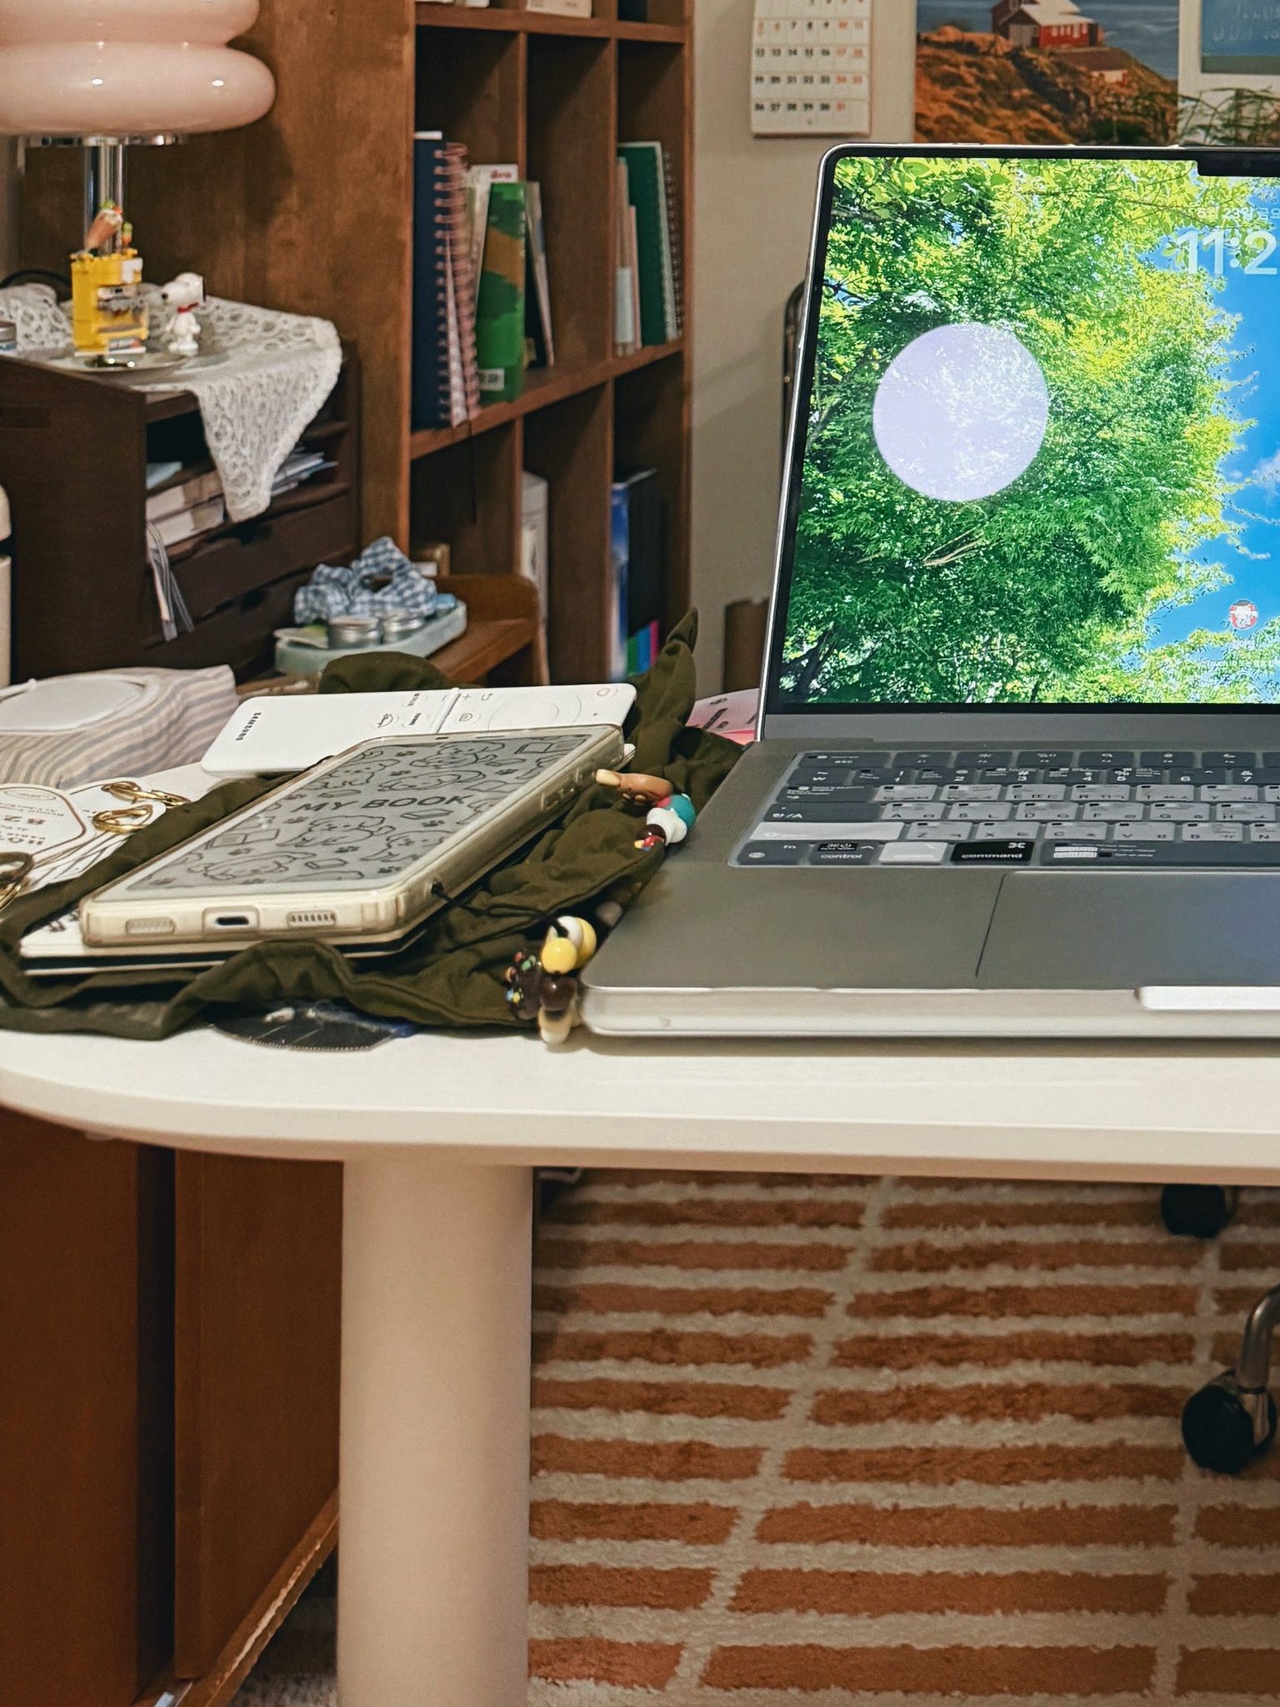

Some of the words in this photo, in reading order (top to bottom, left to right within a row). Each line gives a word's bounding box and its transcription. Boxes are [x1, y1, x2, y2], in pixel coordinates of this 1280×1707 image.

[291, 800, 359, 813] MY
[360, 795, 475, 809] BOOK
[961, 852, 1023, 860] command
